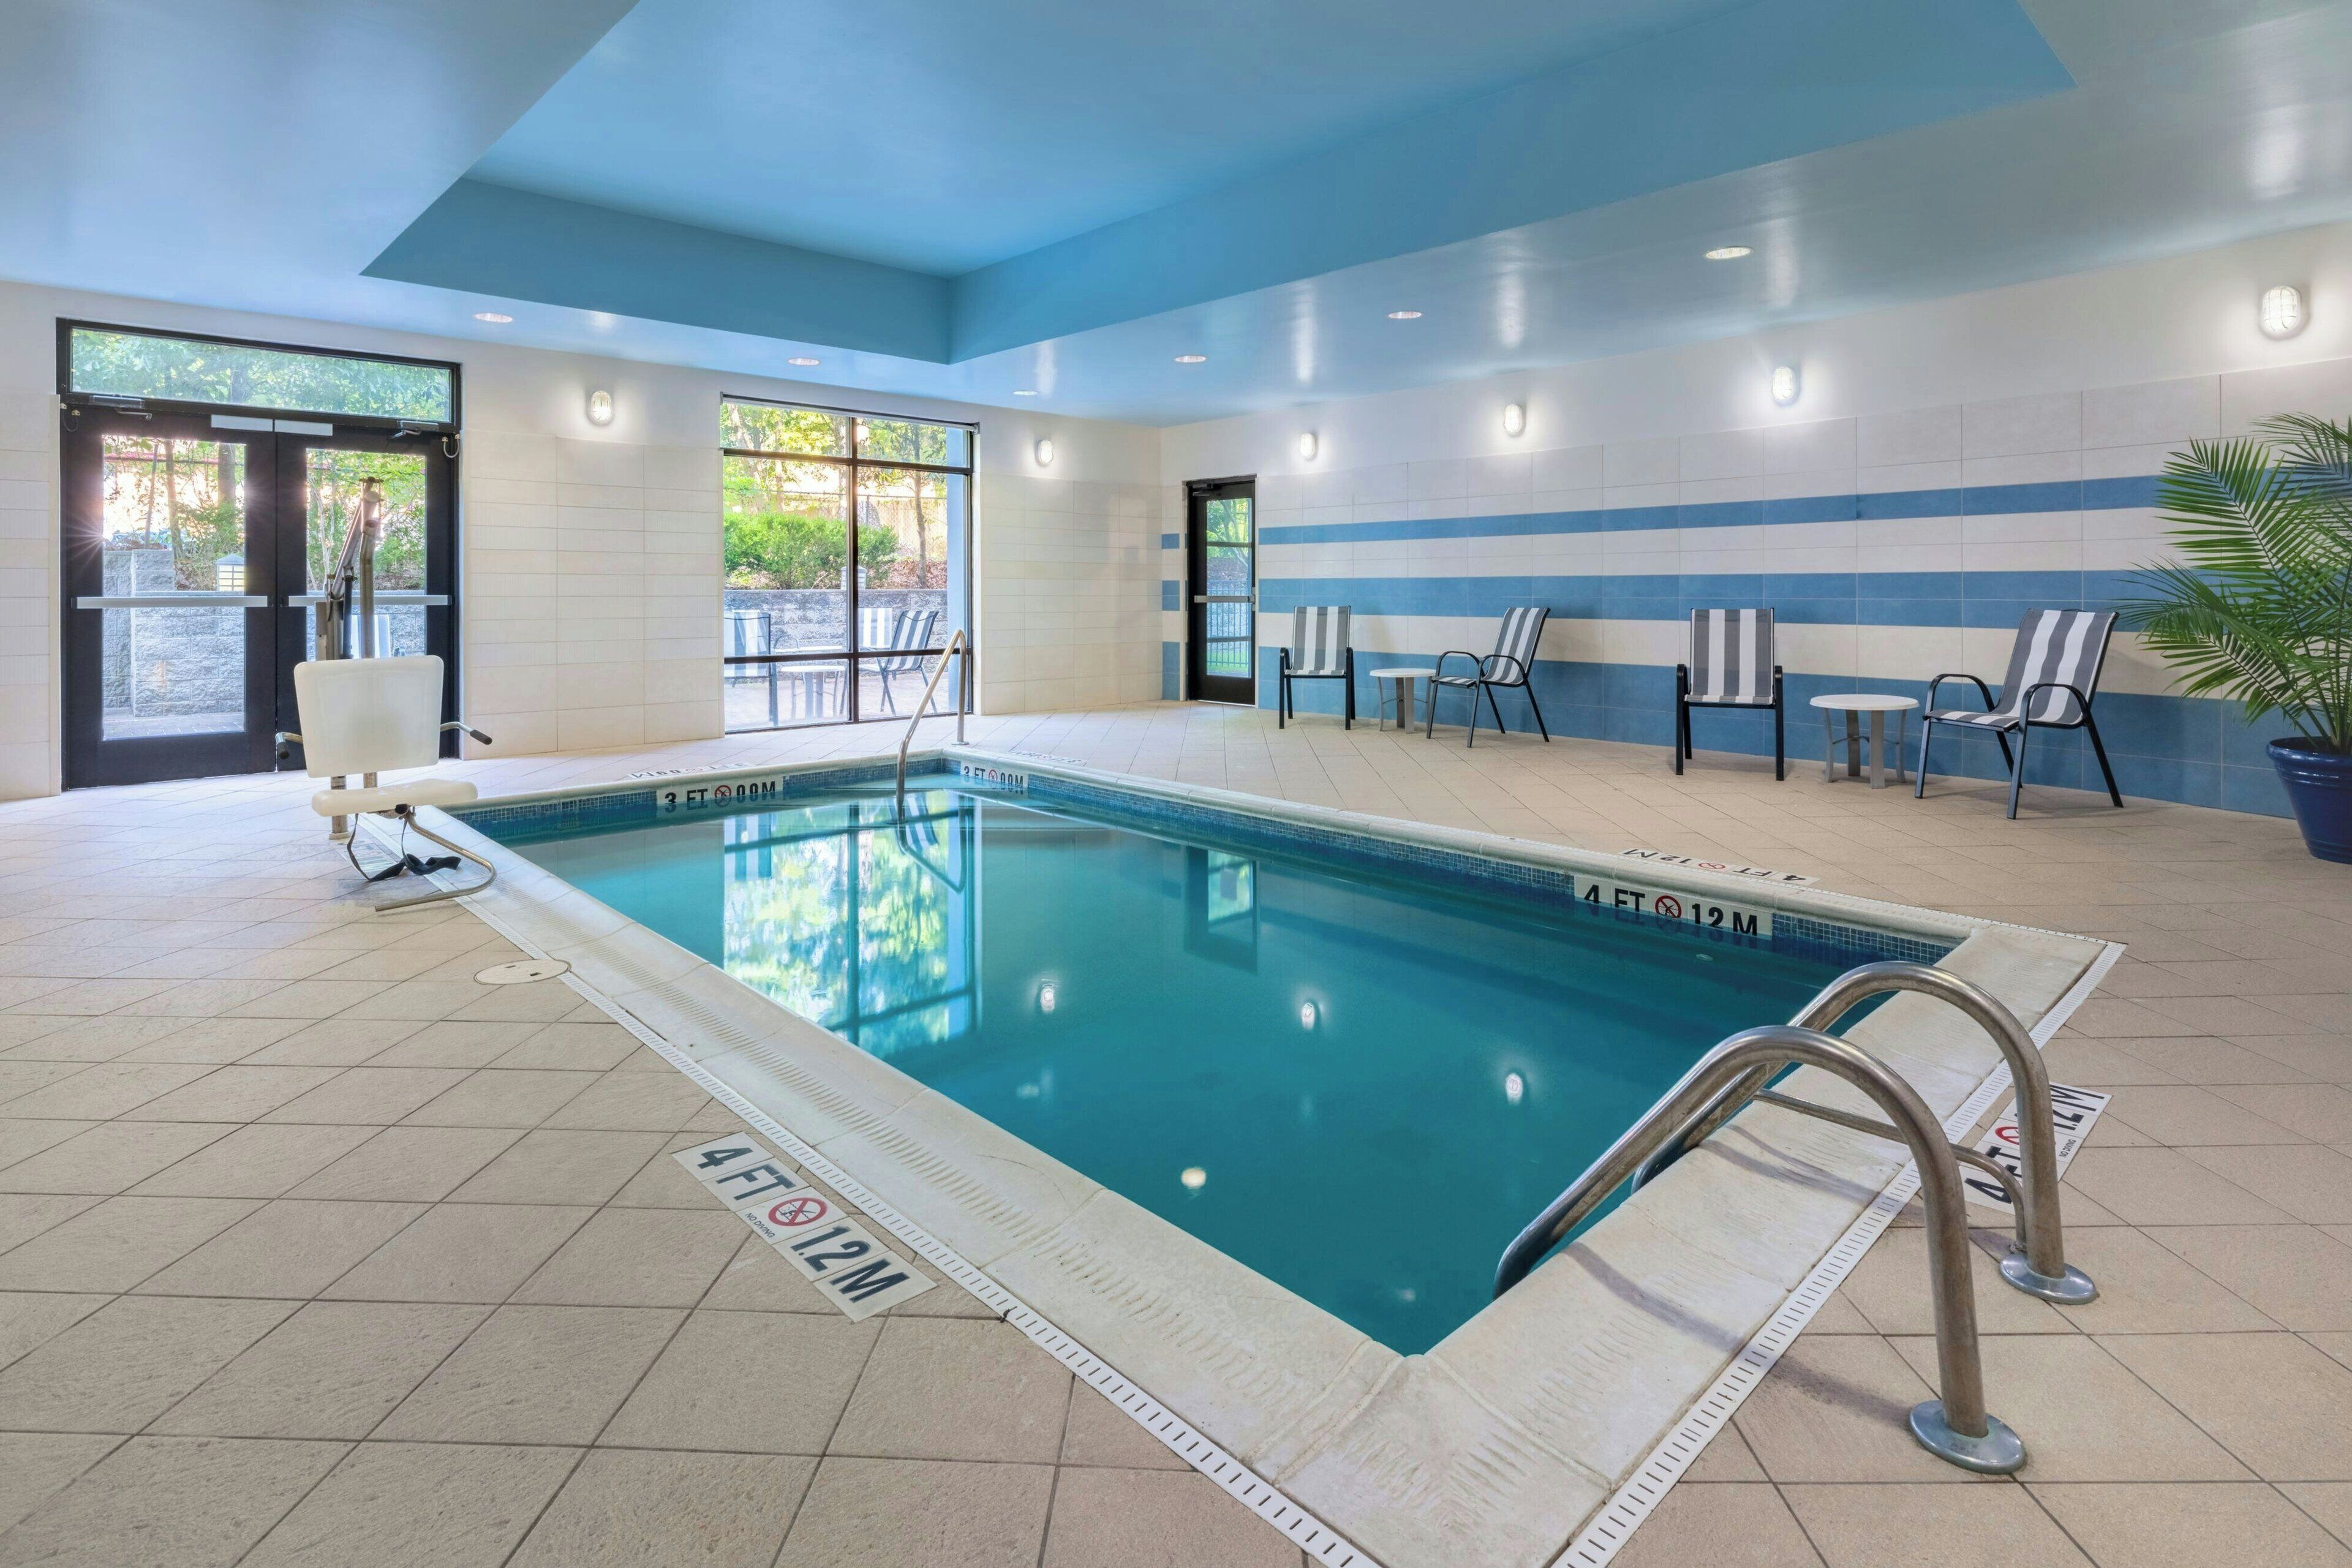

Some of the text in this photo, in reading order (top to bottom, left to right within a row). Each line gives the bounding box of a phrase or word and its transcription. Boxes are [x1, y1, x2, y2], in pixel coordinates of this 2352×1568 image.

[665, 792, 677, 804] 3
[687, 789, 708, 802] FT
[1733, 867, 1773, 876] FT
[1584, 884, 1600, 904] 4
[1615, 888, 1645, 912] FT
[697, 1147, 753, 1169] 4
[716, 1164, 796, 1201] FT
[745, 1212, 775, 1238] NO DIVING
